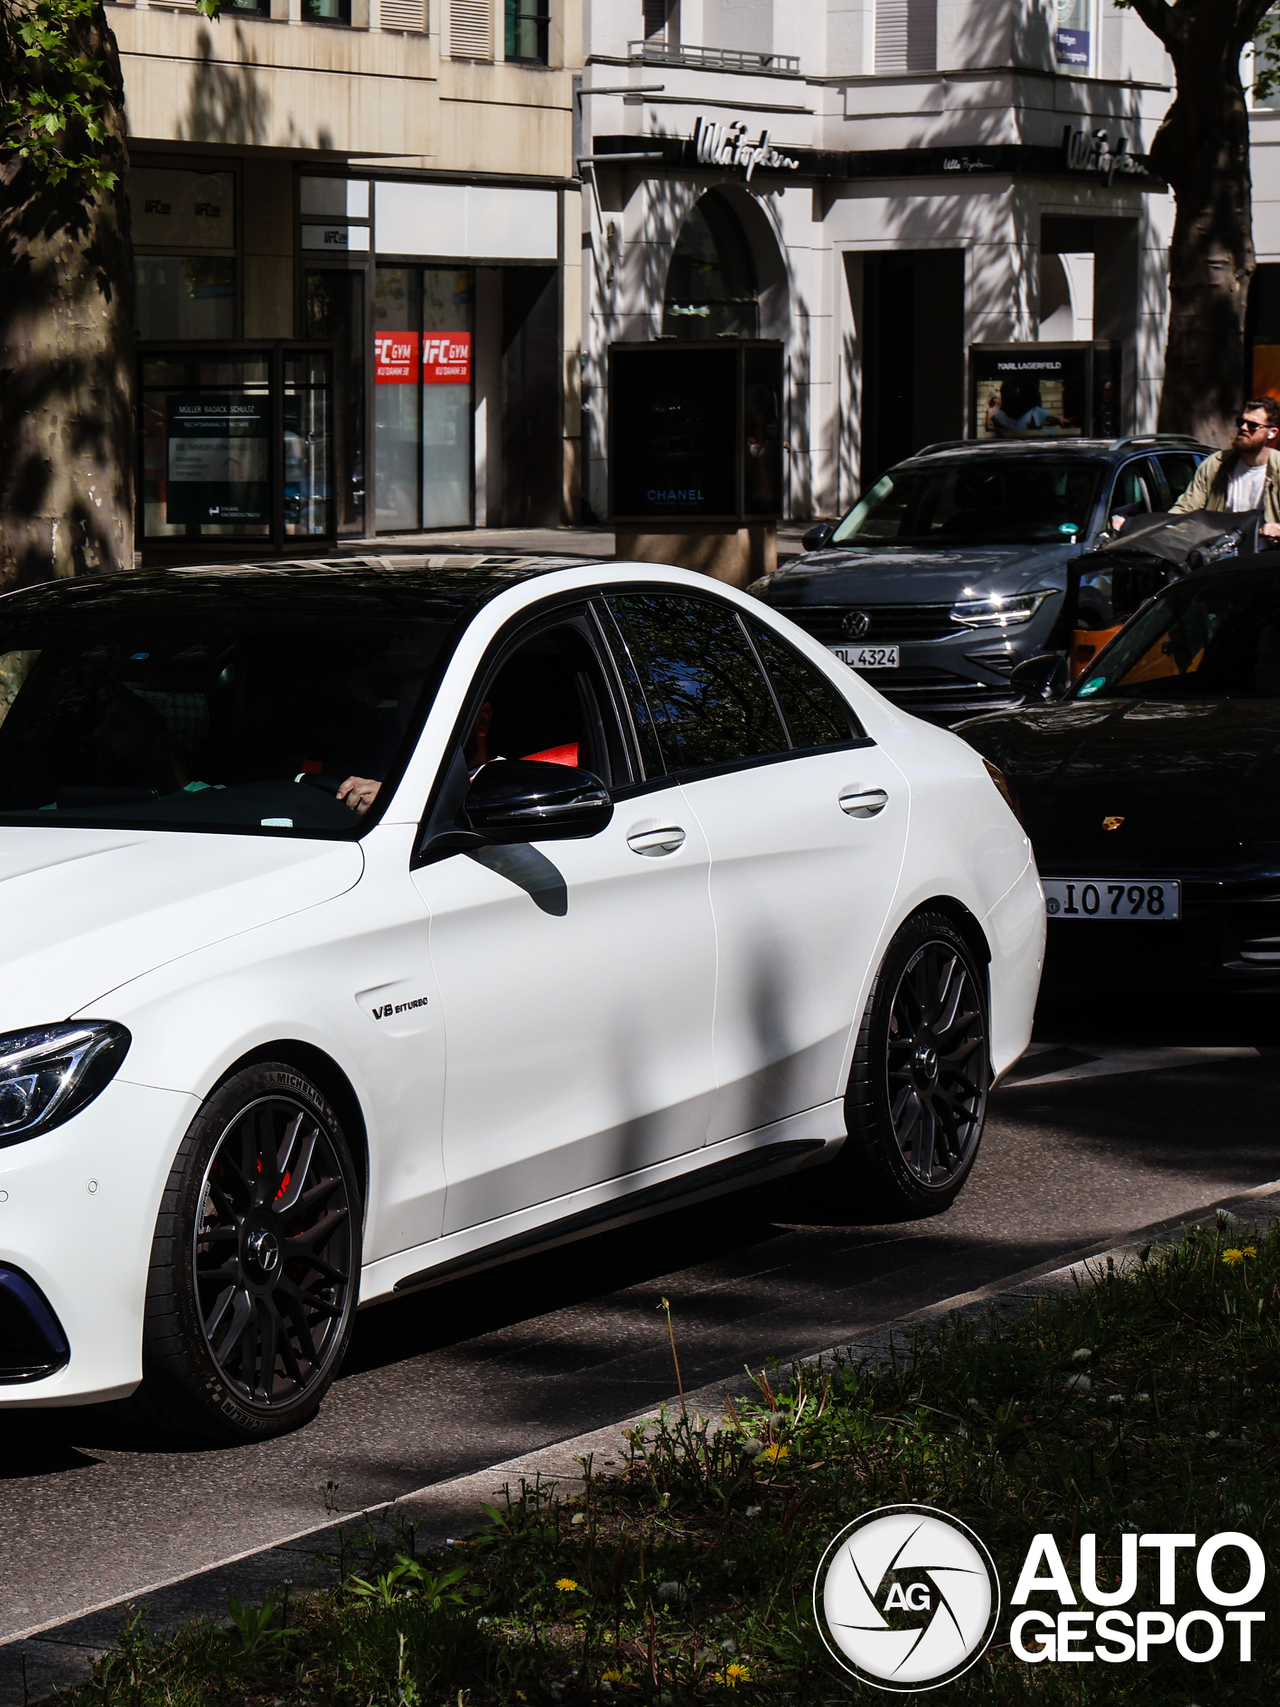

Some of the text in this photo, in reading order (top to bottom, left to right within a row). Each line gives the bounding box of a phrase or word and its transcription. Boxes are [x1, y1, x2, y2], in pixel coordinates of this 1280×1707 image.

[375, 339, 412, 364] FC GYM
[449, 344, 469, 359] GYM
[997, 361, 1062, 370] KARL LAGERFELD
[178, 405, 202, 414] MÜLLER
[229, 404, 255, 413] SCHULTZ
[646, 489, 705, 501] CHANEL
[858, 649, 896, 666] 4324
[1107, 885, 1165, 915] 798
[372, 997, 428, 1020] V8 BITURBO
[276, 1072, 324, 1108] MICHELIN
